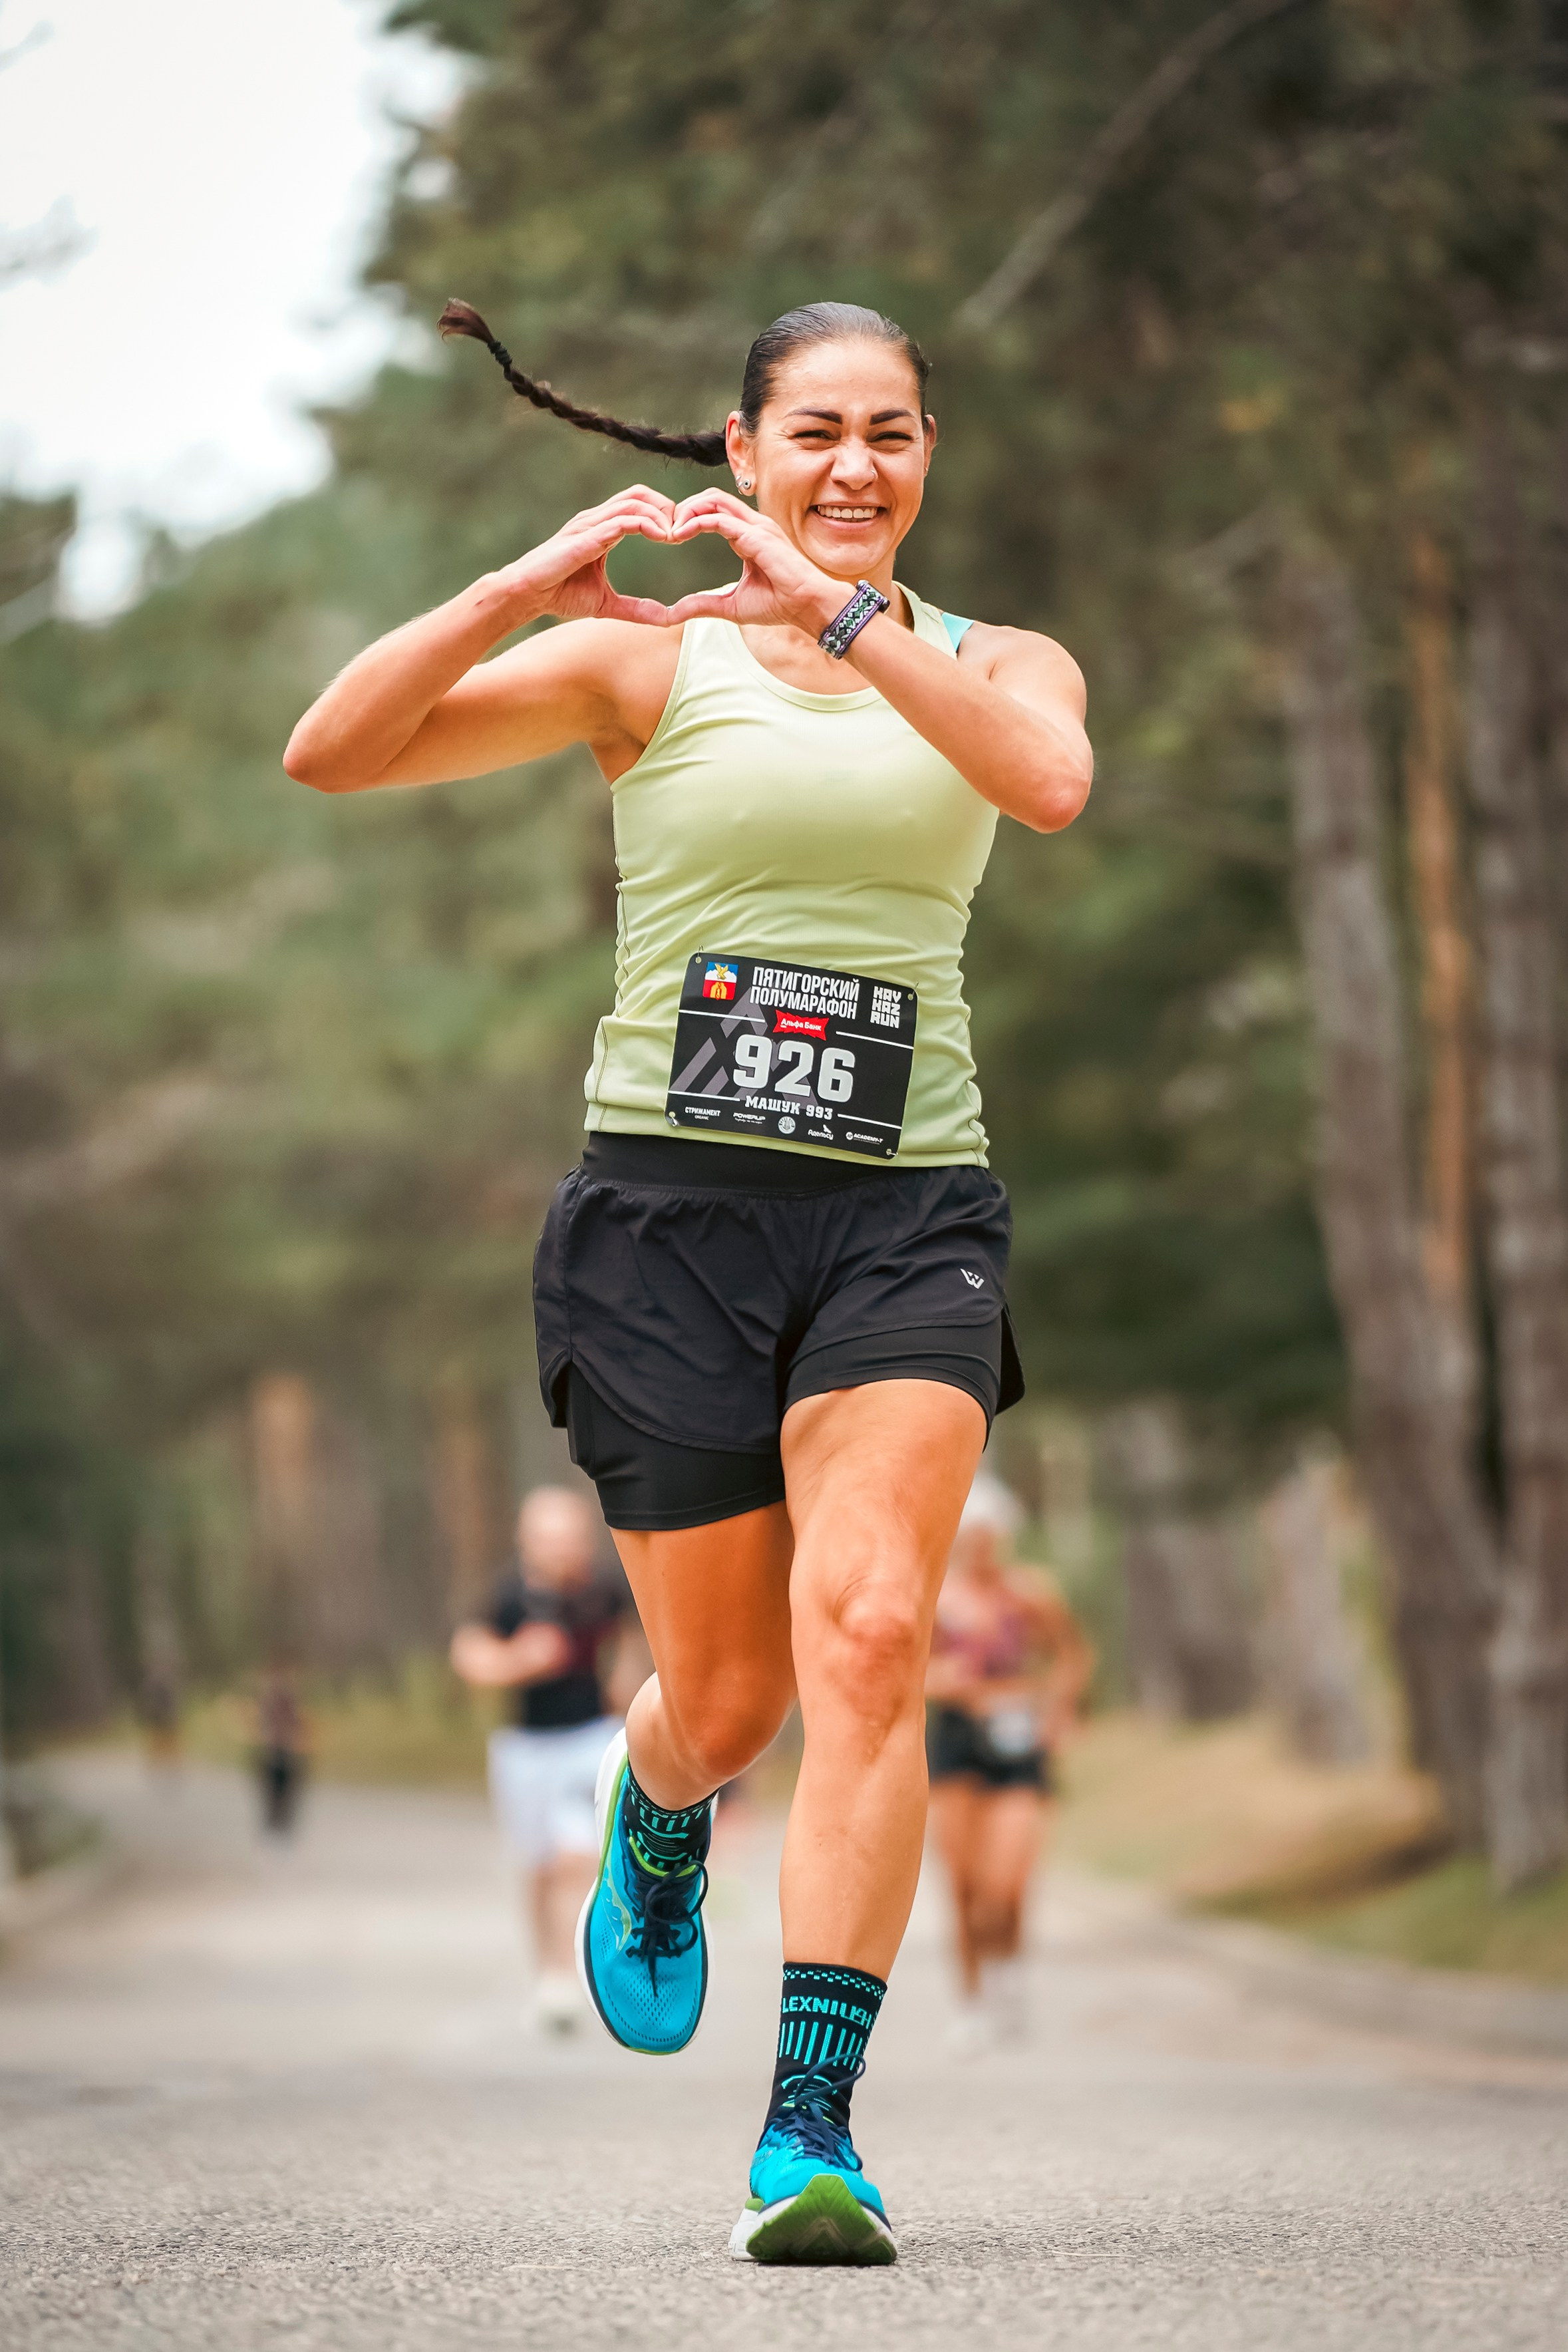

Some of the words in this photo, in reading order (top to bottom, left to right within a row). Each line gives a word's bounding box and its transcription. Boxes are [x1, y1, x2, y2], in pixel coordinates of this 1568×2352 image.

[752, 966, 860, 1001] ПЯТИГОРСКИЙ
[750, 985, 858, 1019] ПОЛУМАРАФОН
[780, 1018, 804, 1029] Альфа
[804, 1021, 822, 1031] Банк
[870, 1010, 899, 1029] RUN
[733, 1034, 856, 1102] 926
[685, 1106, 720, 1116] СТРИЖАМЕНТ
[733, 1112, 766, 1120] POWERUP
[745, 1095, 800, 1115] МАШУК
[806, 1104, 833, 1120] 993
